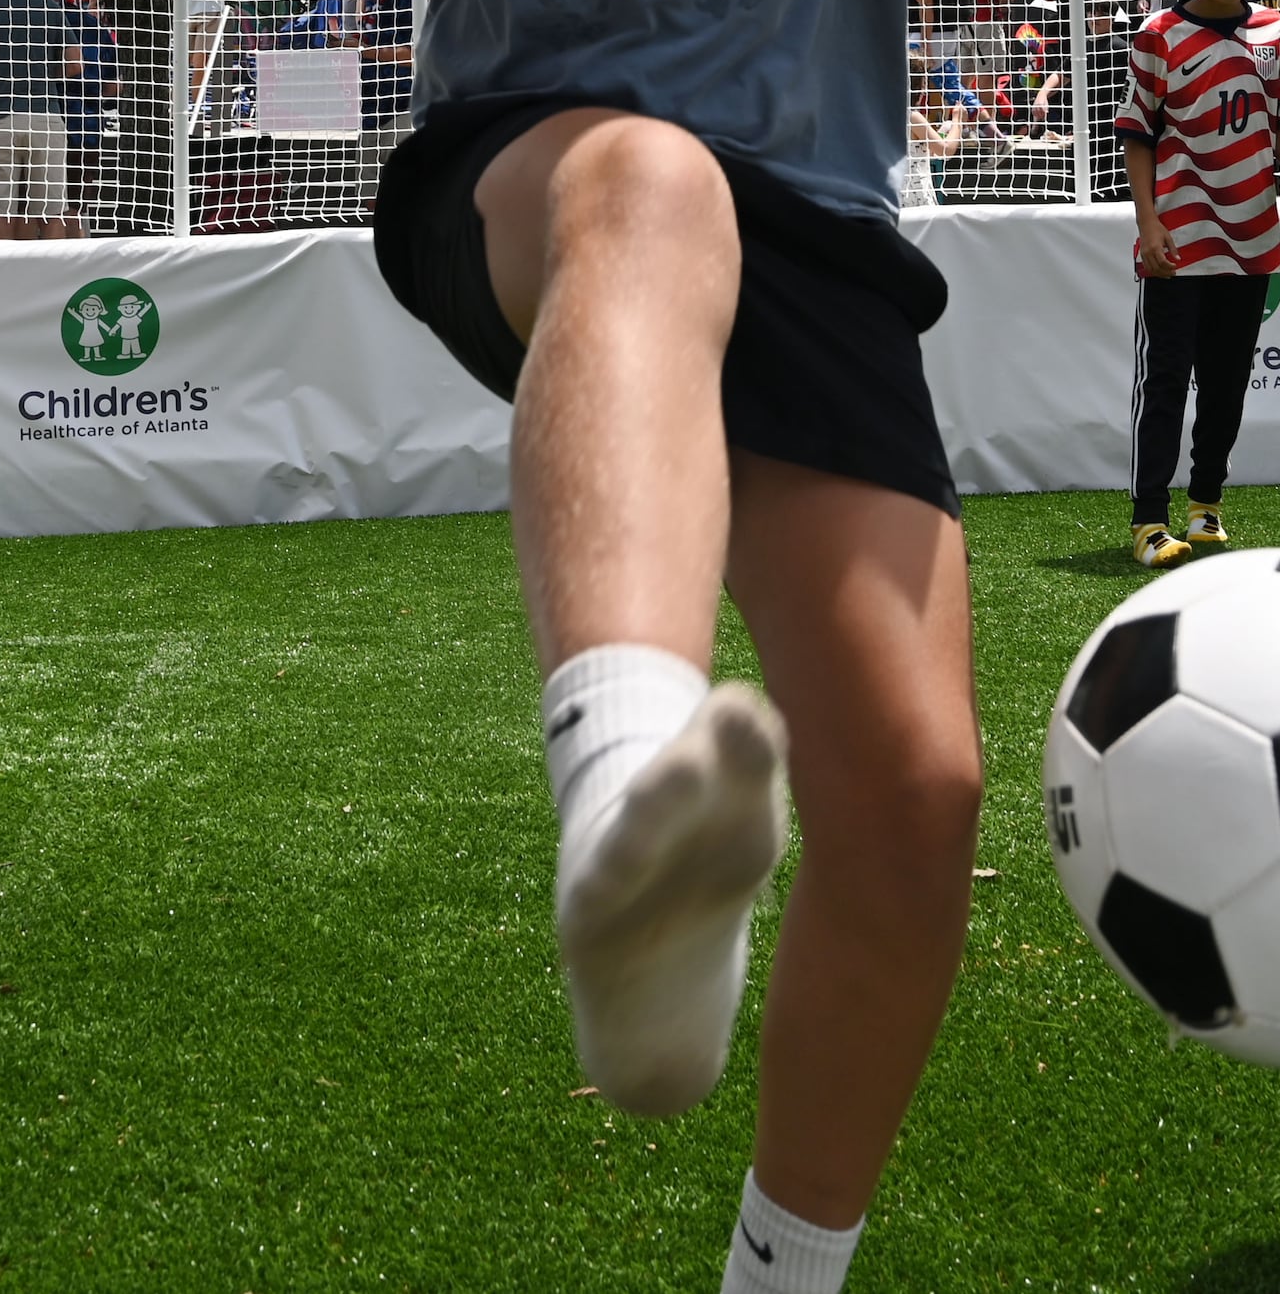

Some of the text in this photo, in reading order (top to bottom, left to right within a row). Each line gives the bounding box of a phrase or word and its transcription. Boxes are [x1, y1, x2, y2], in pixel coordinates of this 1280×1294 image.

[1254, 47, 1275, 60] USA
[1218, 89, 1250, 136] 10
[1251, 377, 1268, 390] of
[18, 381, 208, 421] Children's
[20, 418, 209, 441] Healthcare of Atlanta
